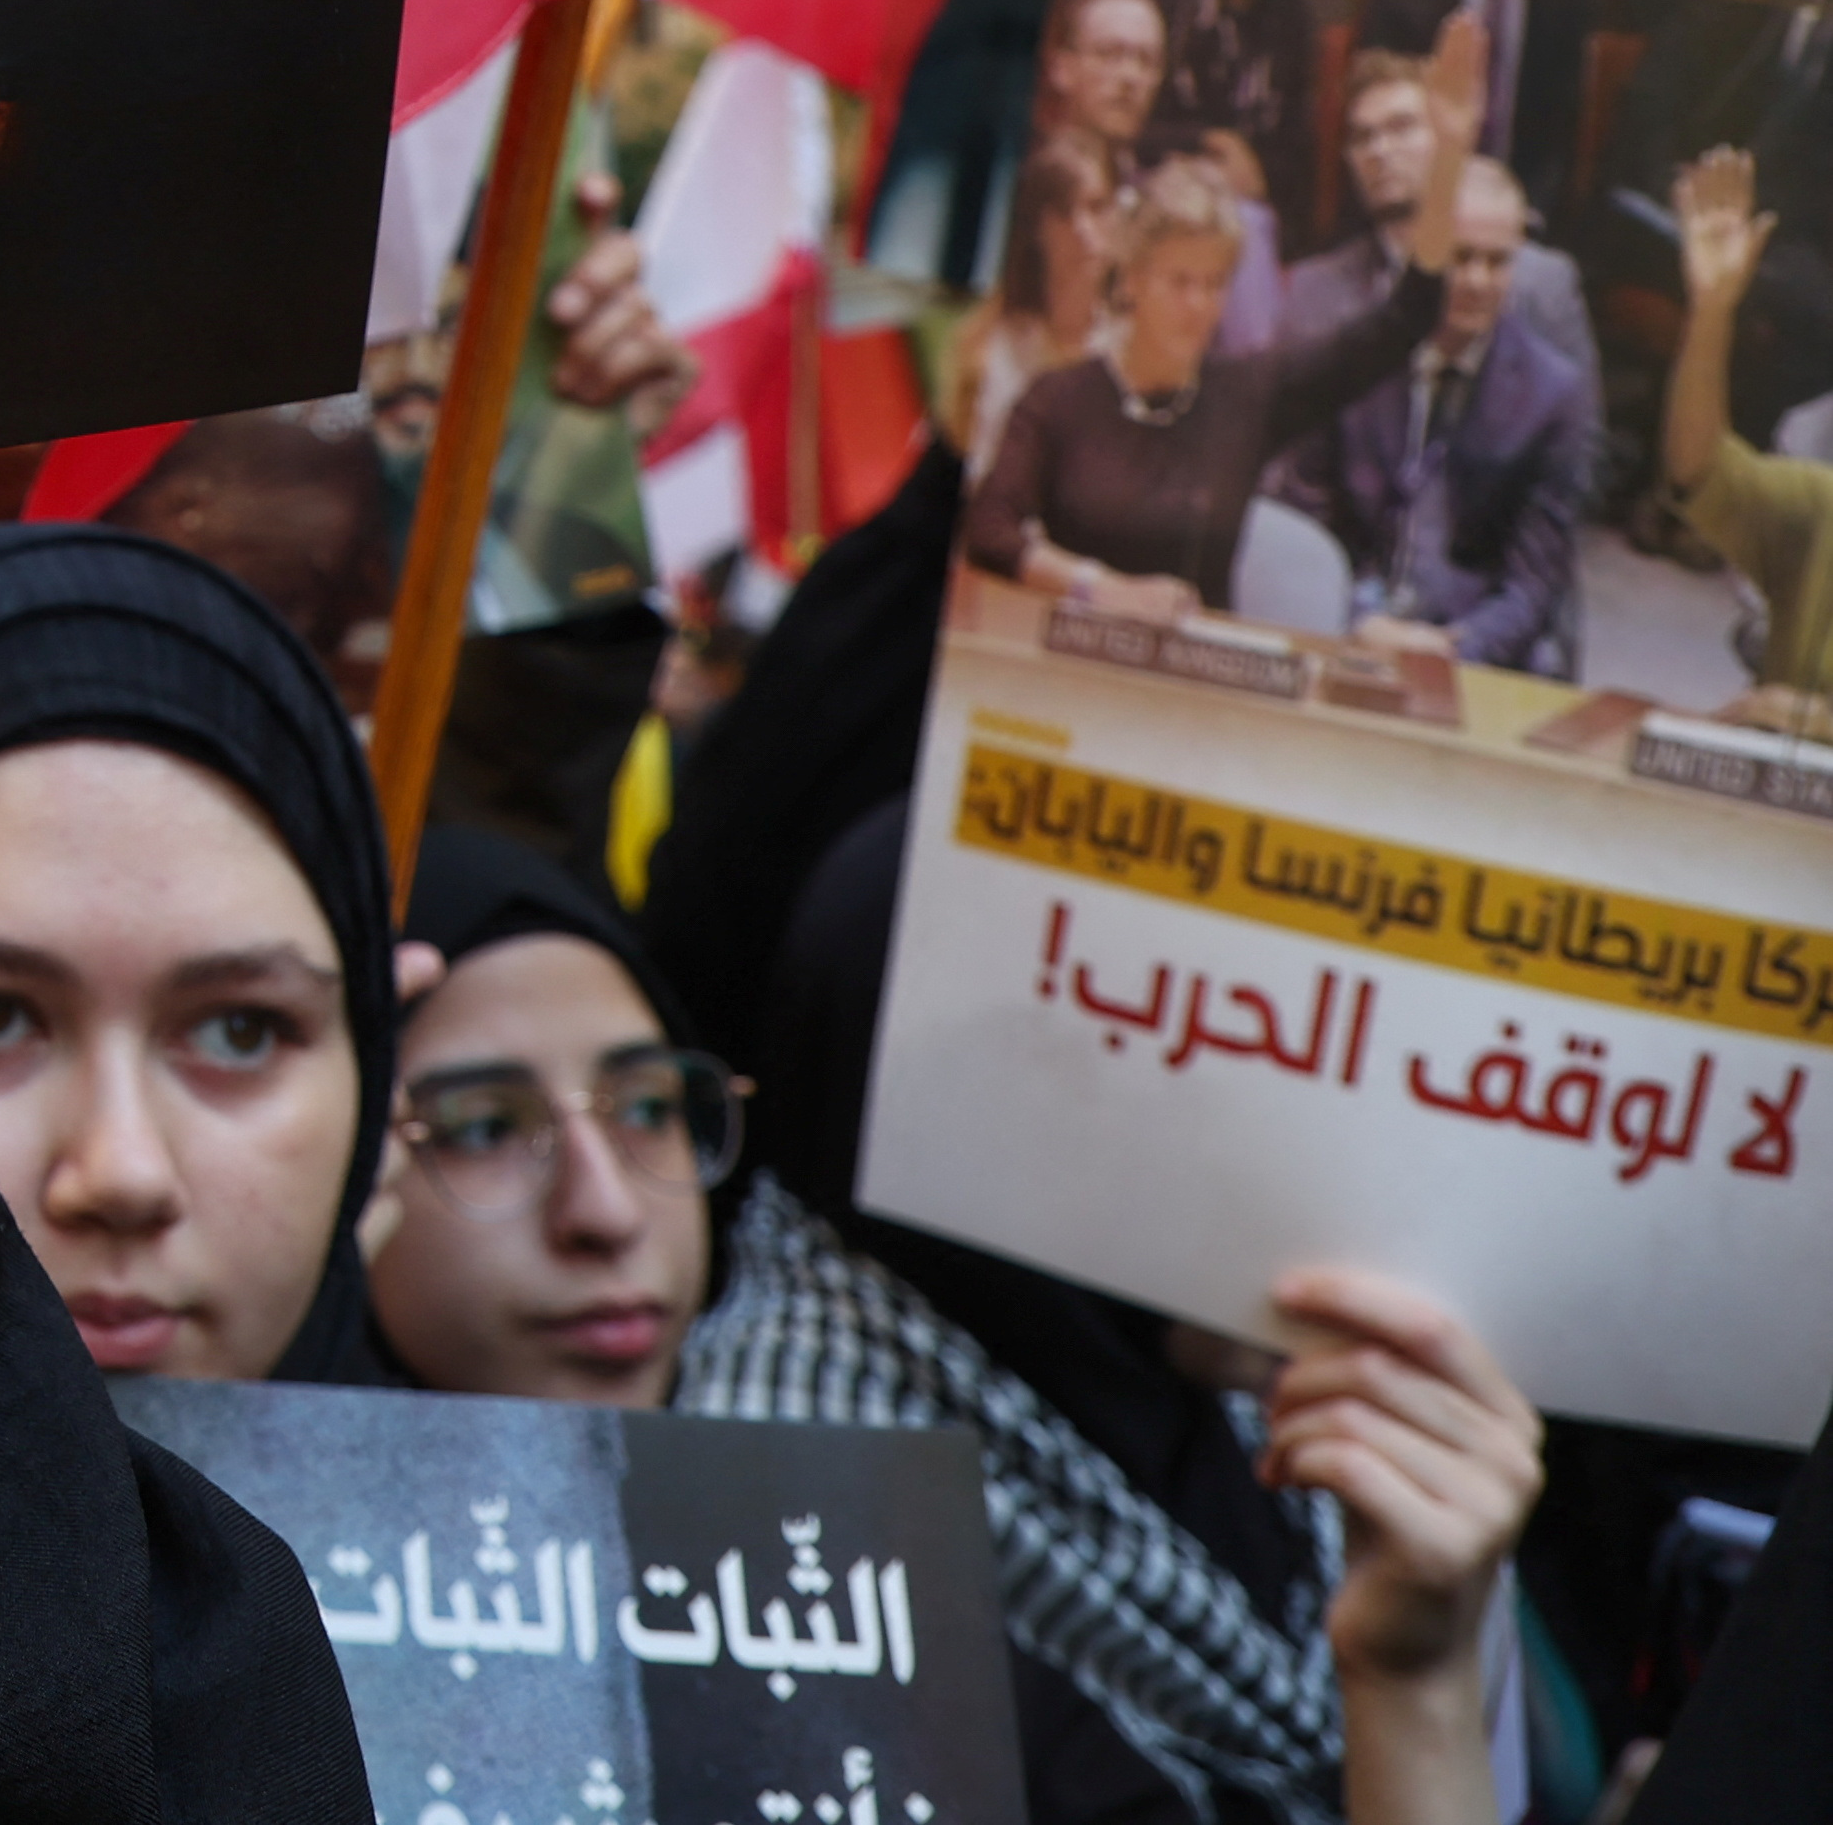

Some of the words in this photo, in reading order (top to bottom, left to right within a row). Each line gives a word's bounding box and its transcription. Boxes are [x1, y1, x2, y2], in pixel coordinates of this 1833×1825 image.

[1637, 733, 1755, 794] UNITED
[1241, 817, 1444, 937] فرنسا
[1035, 900, 1379, 1089] الحرب!
[1462, 869, 1724, 1011] بريطانيا
[1741, 923, 1833, 1030] ركا
[1407, 1017, 1715, 1185] لوقف
[1726, 1067, 1809, 1179] لا
